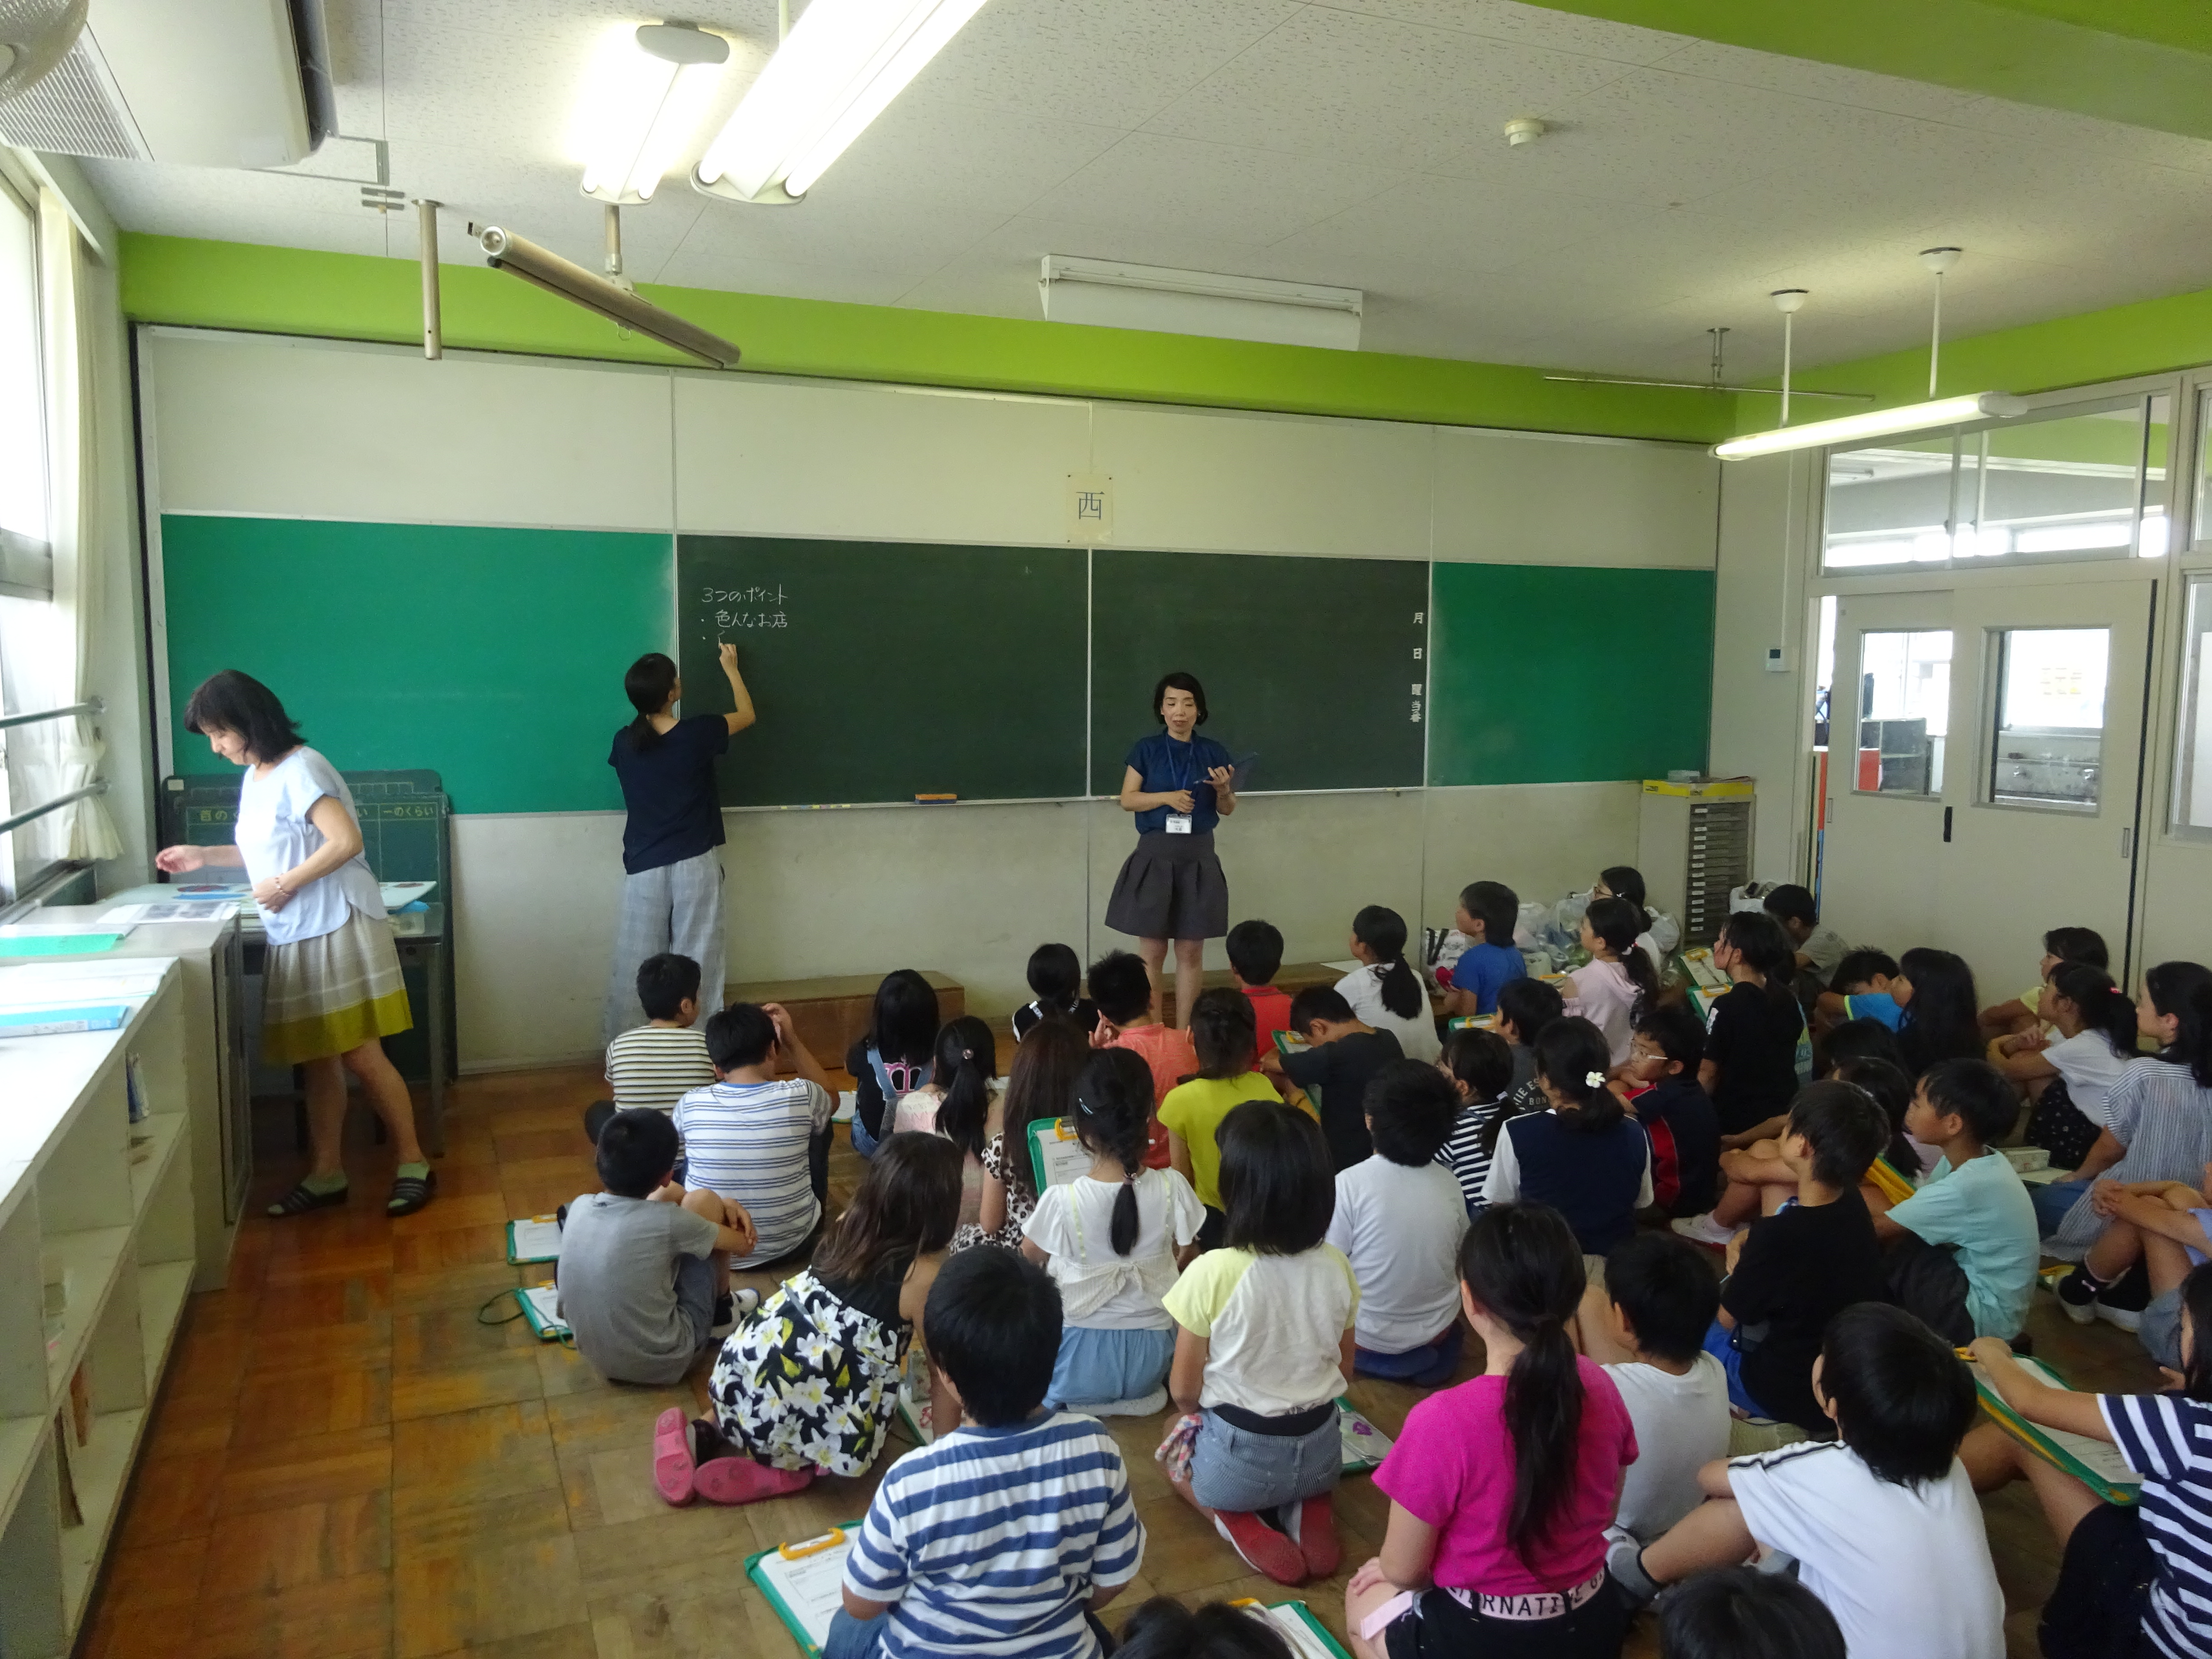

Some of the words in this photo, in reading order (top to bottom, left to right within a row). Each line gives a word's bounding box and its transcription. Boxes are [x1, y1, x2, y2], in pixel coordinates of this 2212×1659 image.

[1076, 491, 1105, 520] 西
[702, 583, 788, 605] 3つのポイント
[1413, 612, 1424, 624] 月
[1413, 648, 1422, 659] 日
[384, 806, 433, 817] 一のくらい
